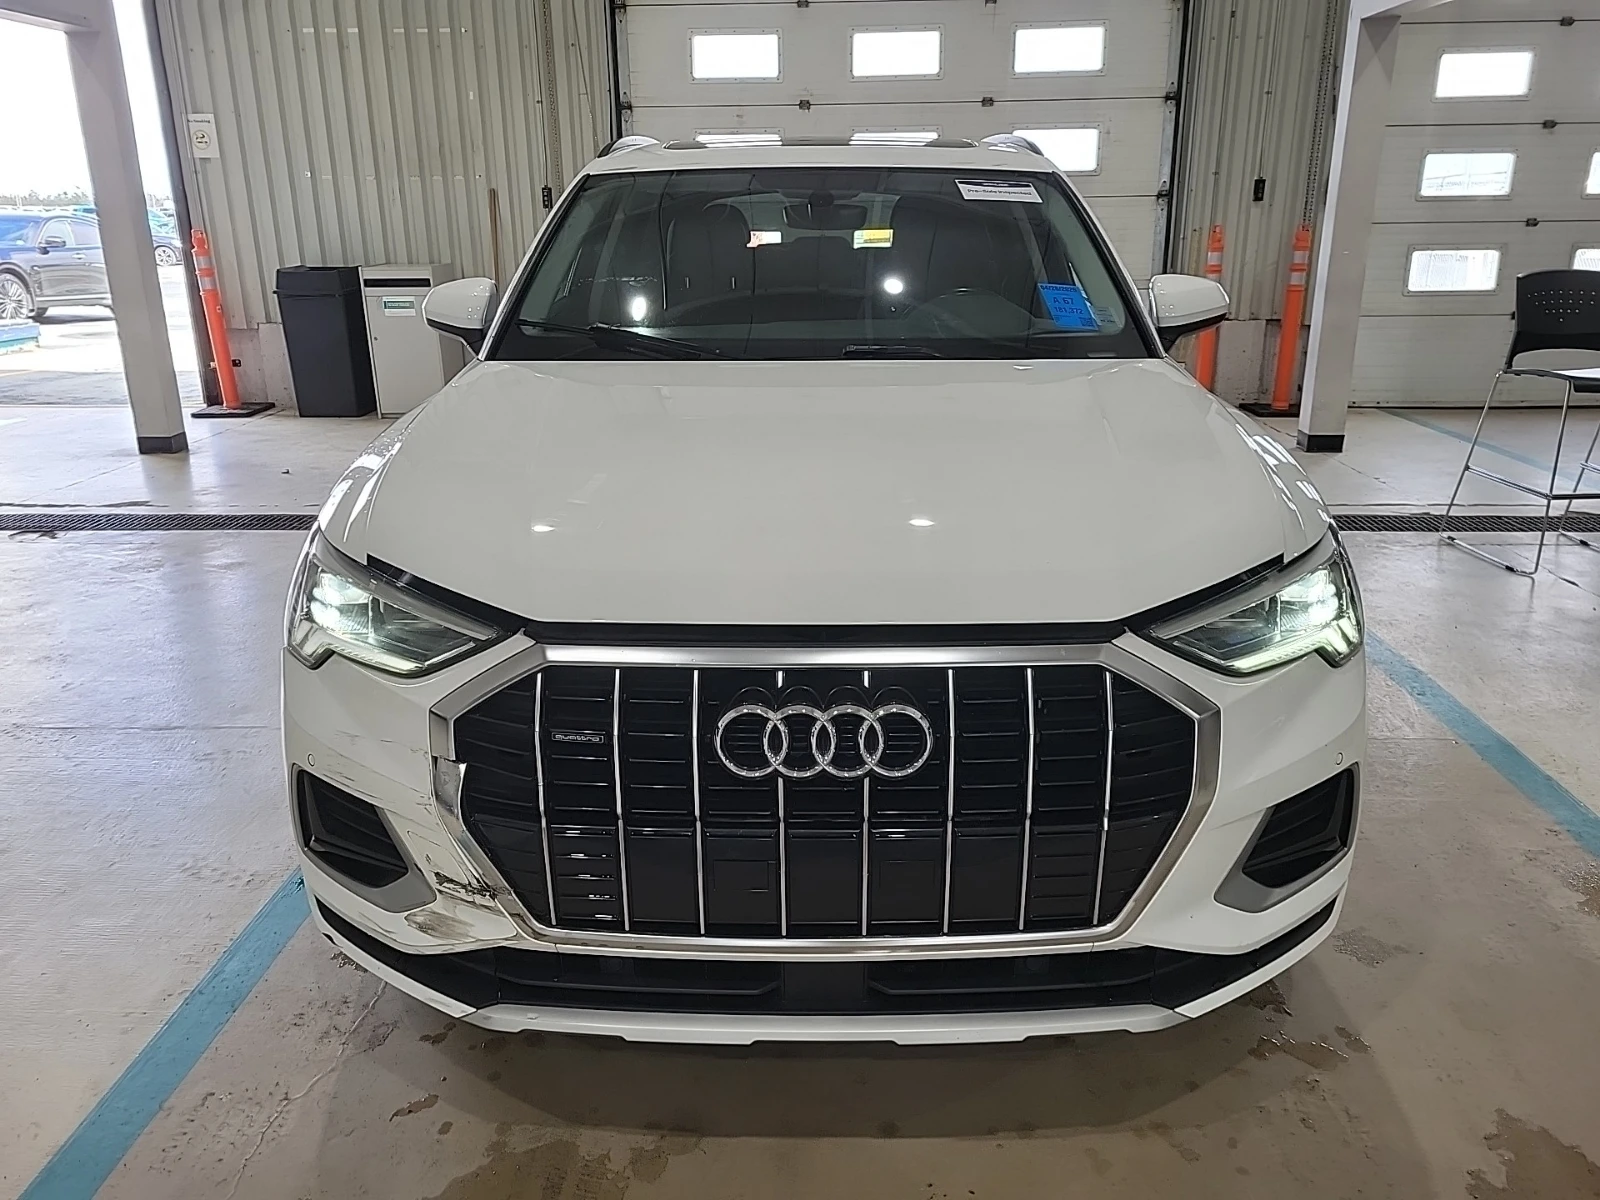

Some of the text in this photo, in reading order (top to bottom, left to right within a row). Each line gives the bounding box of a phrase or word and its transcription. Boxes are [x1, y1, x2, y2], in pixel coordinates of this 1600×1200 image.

[1053, 296, 1074, 305] A 67
[555, 734, 600, 742] quattro
